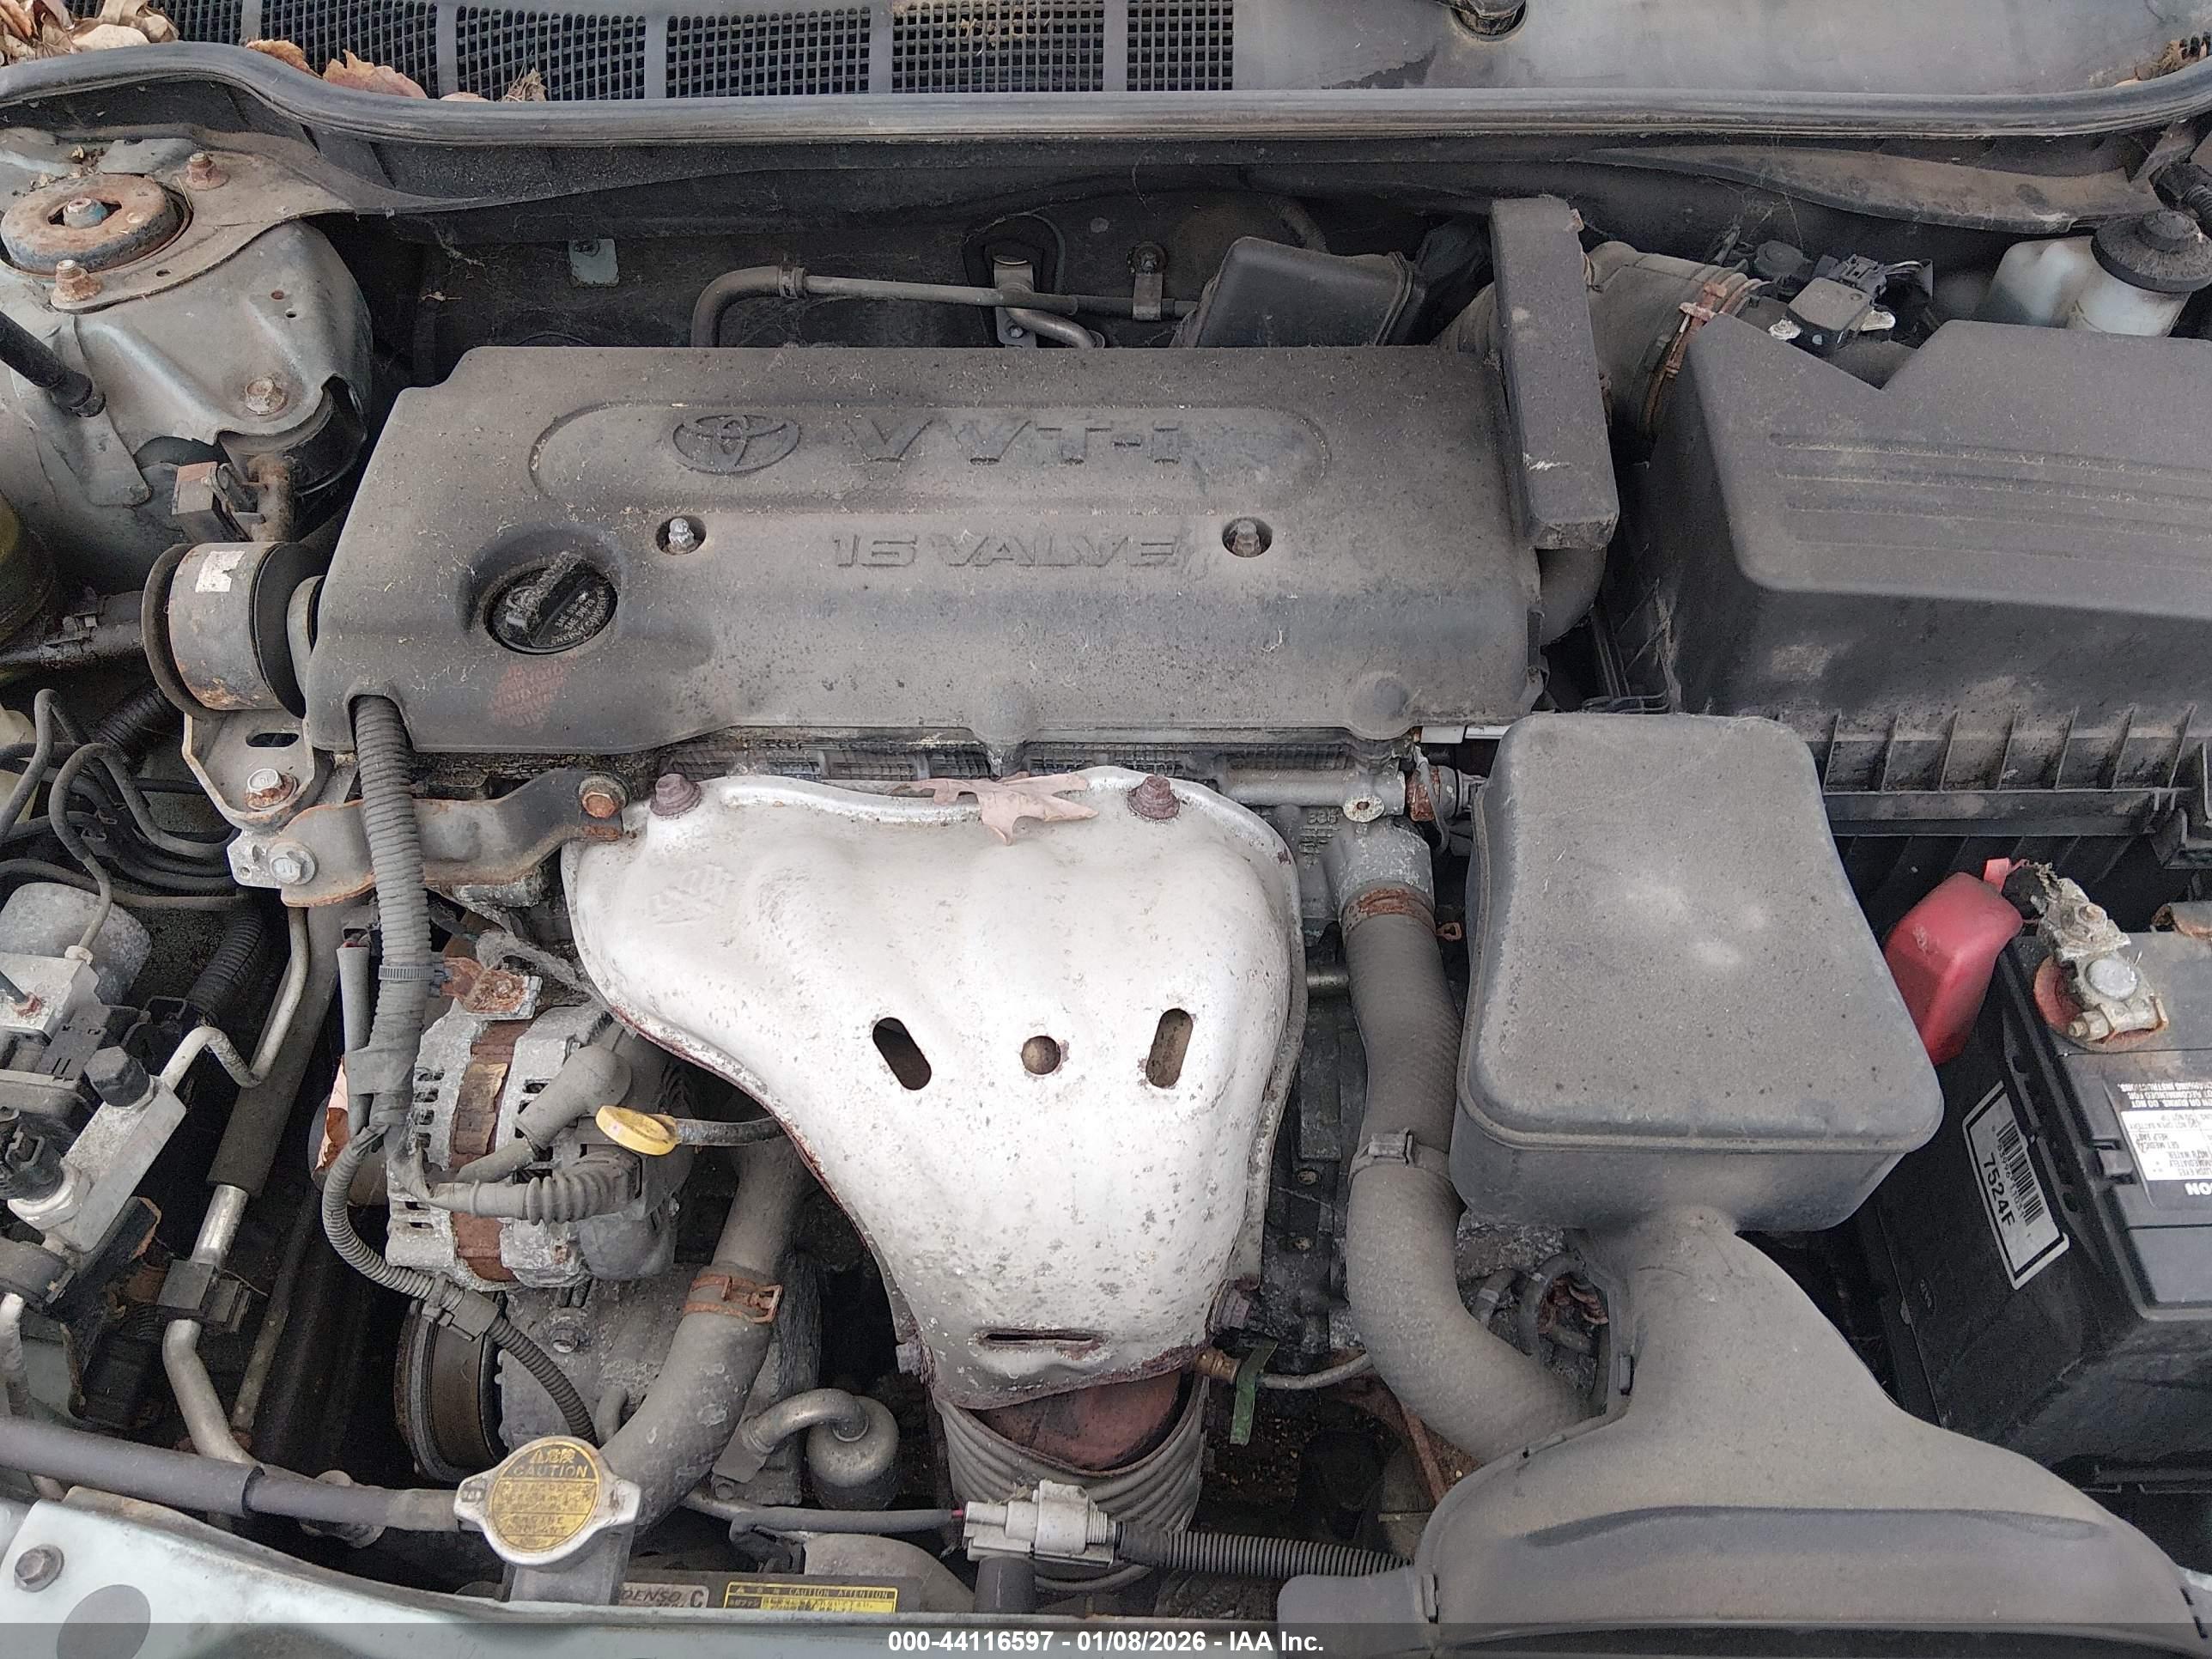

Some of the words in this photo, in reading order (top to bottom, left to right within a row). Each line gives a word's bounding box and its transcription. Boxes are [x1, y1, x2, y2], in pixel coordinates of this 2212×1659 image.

[833, 533, 917, 568] 16
[945, 533, 1179, 568] VALVE
[550, 624, 586, 645] ENERGY
[1983, 1152, 2015, 1226] 7524F
[513, 1464, 588, 1478] CAUTION
[788, 1588, 830, 1597] CAUTION
[837, 1589, 889, 1599] ATTENTION
